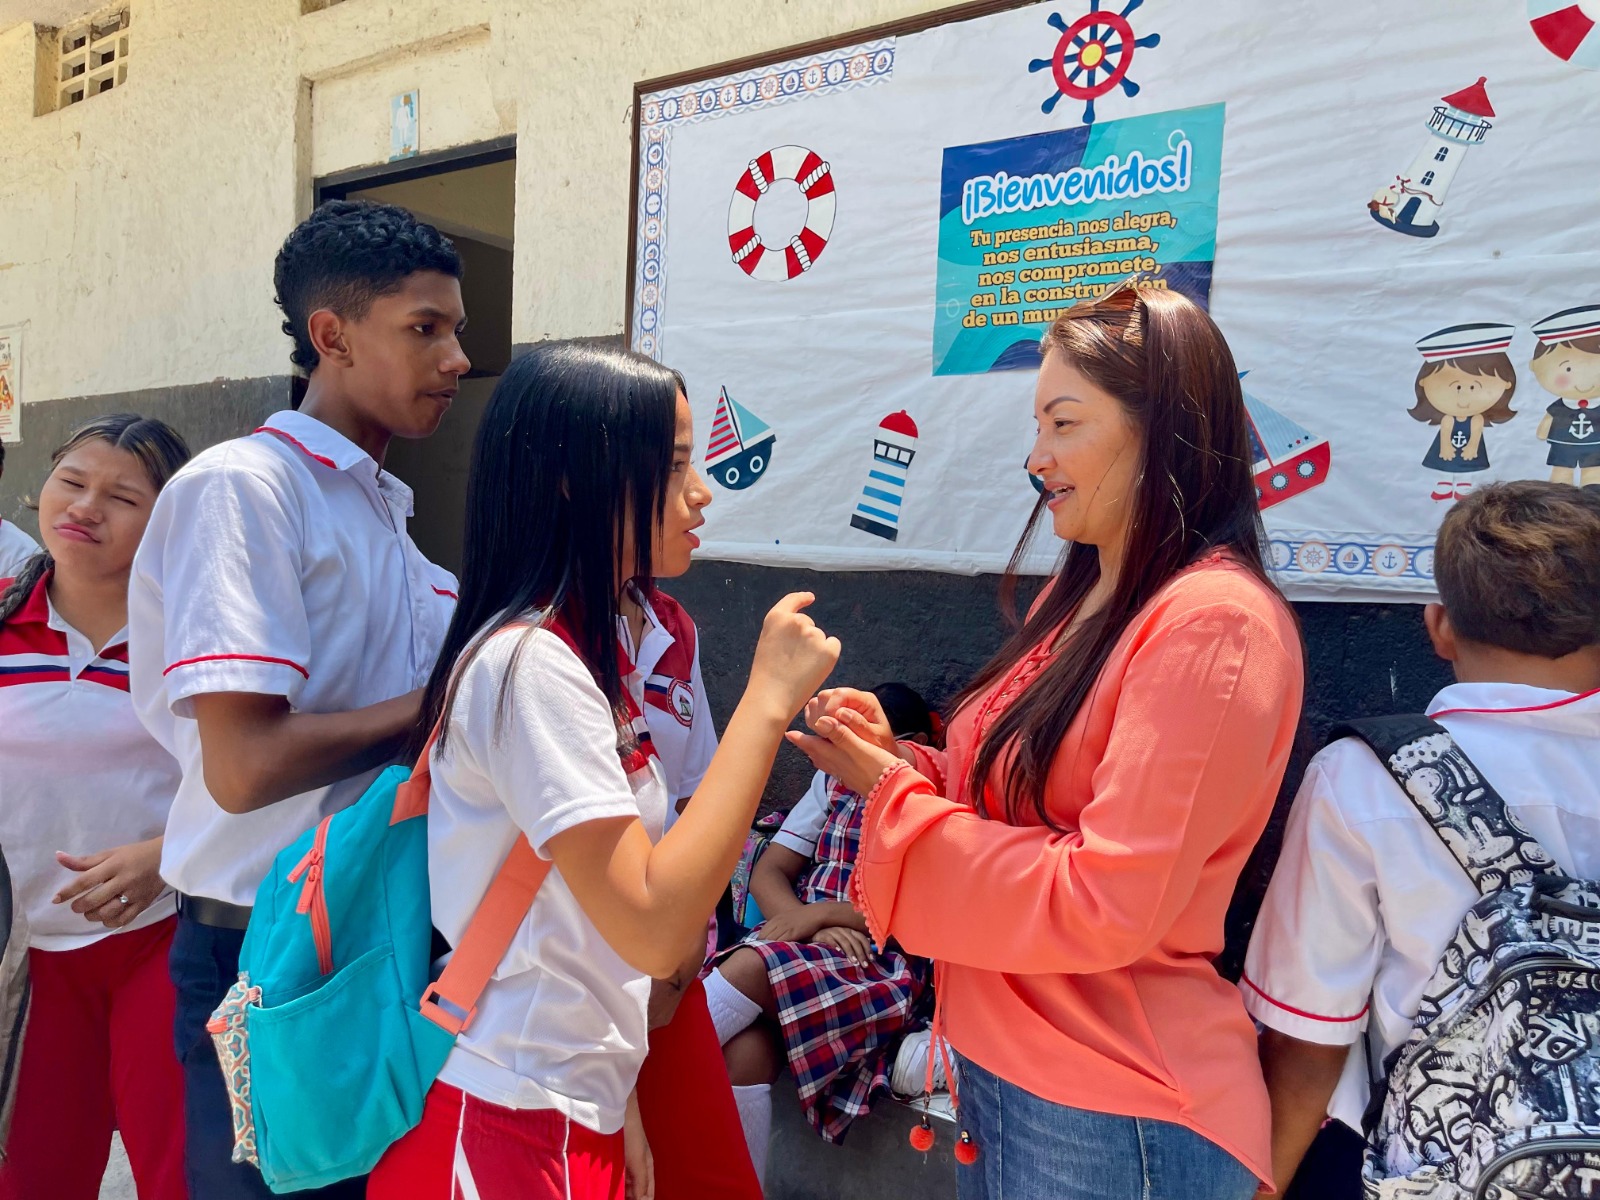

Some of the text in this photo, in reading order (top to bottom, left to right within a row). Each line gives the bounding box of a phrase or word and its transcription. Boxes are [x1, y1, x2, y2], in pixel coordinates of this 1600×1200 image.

[964, 143, 1190, 222] ¡Bienvenidos!
[970, 210, 1178, 248] Tu presencia nos alegra,
[983, 236, 1159, 266] nos entusiasma,
[978, 256, 1162, 287] nos compromete,
[971, 276, 1168, 307] en la construión
[962, 311, 988, 328] de
[991, 311, 1018, 326] un
